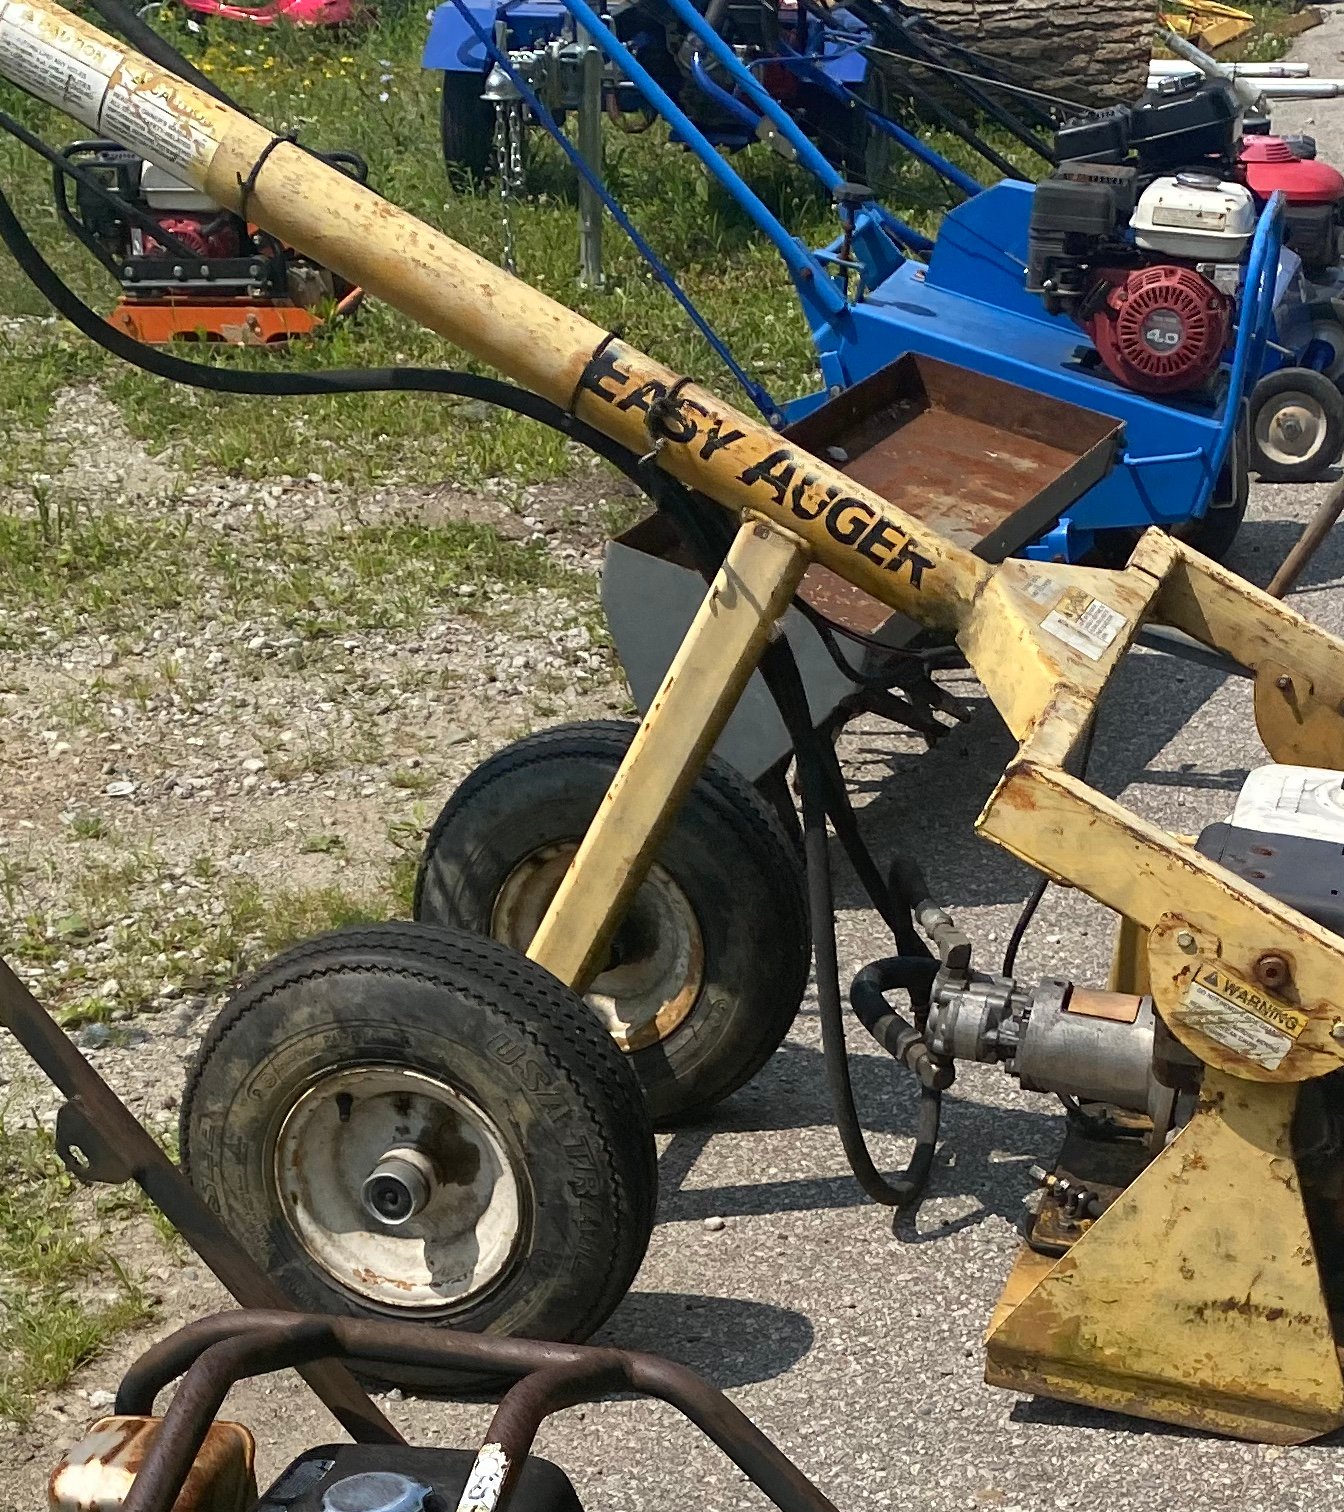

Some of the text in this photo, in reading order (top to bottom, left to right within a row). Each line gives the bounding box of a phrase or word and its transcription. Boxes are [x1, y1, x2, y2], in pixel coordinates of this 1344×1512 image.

[1146, 328, 1179, 345] 4.0
[579, 349, 938, 591] EASY AUGER
[1220, 979, 1300, 1031] WARNING
